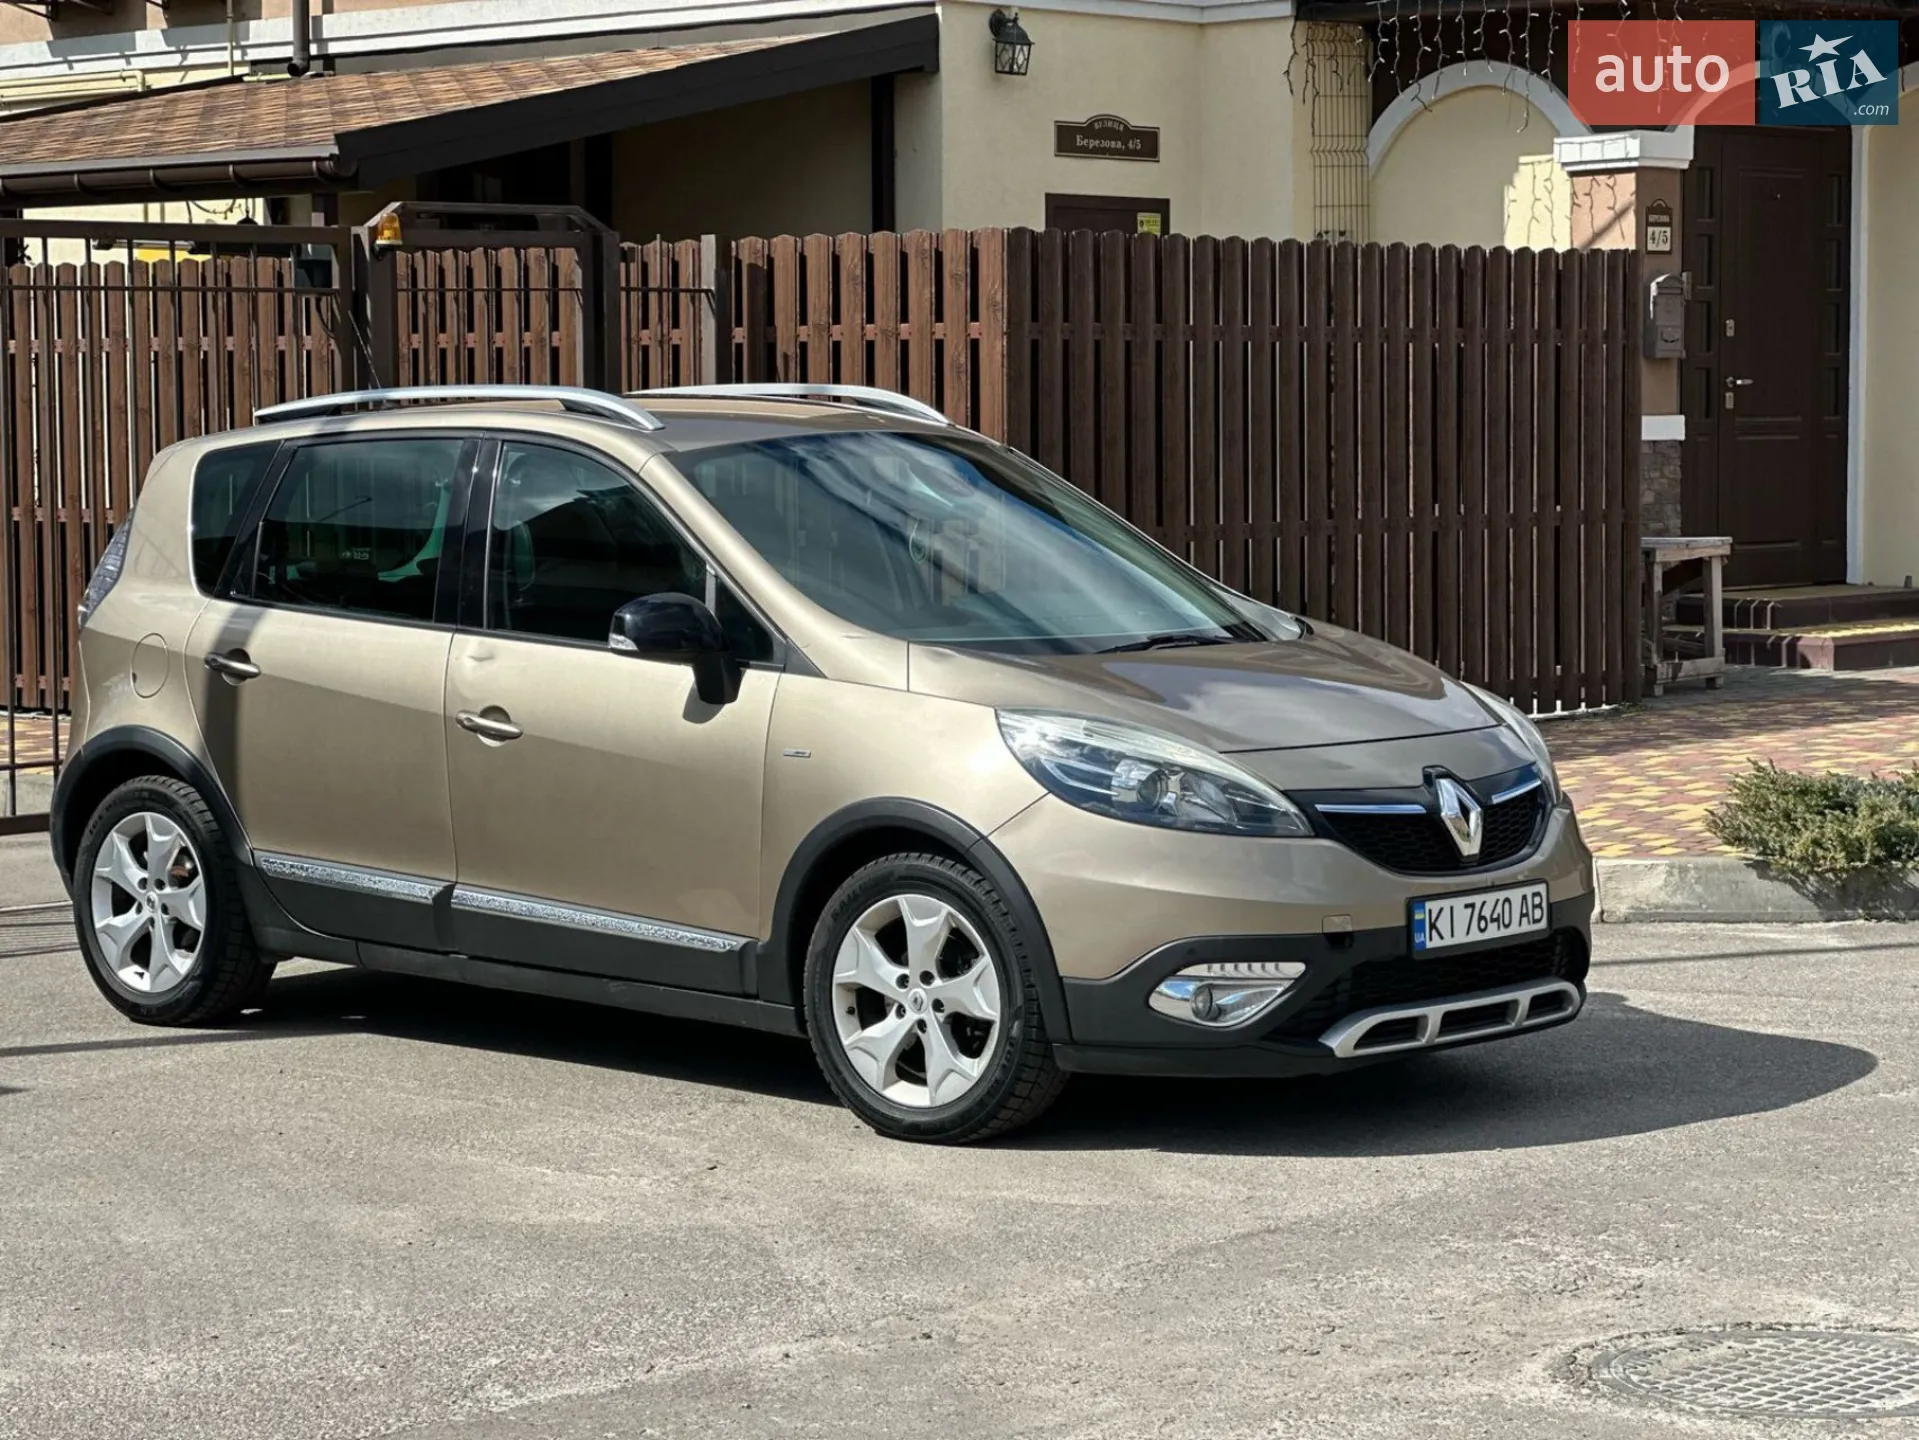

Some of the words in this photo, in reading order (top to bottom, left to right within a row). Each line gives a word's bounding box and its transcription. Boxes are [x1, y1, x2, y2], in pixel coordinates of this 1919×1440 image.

[1076, 134, 1125, 150] Березова,
[1128, 138, 1141, 150] 4/5
[1650, 230, 1668, 248] 4/5
[1428, 905, 1454, 942] KI
[1464, 897, 1512, 936] 7640
[1518, 891, 1544, 927] AB
[1414, 932, 1425, 943] UA
